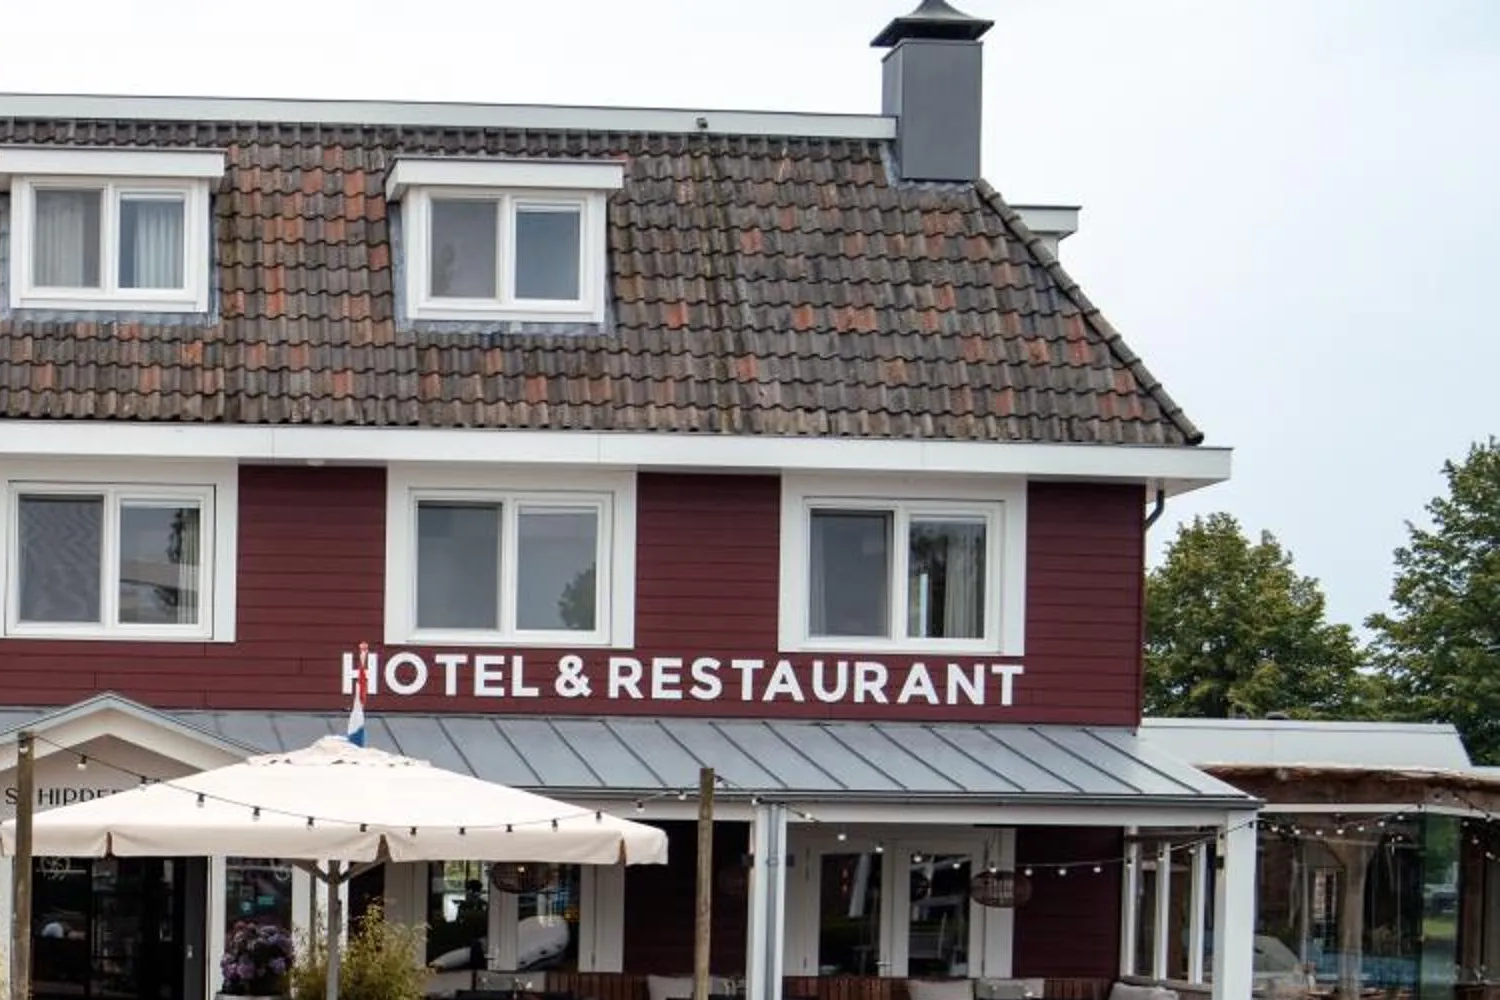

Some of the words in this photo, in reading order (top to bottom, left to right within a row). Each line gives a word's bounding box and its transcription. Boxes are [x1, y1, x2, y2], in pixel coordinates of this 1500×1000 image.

[341, 652, 540, 698] HOTEL
[554, 654, 593, 698] &
[607, 656, 1025, 707] RESTAURANT
